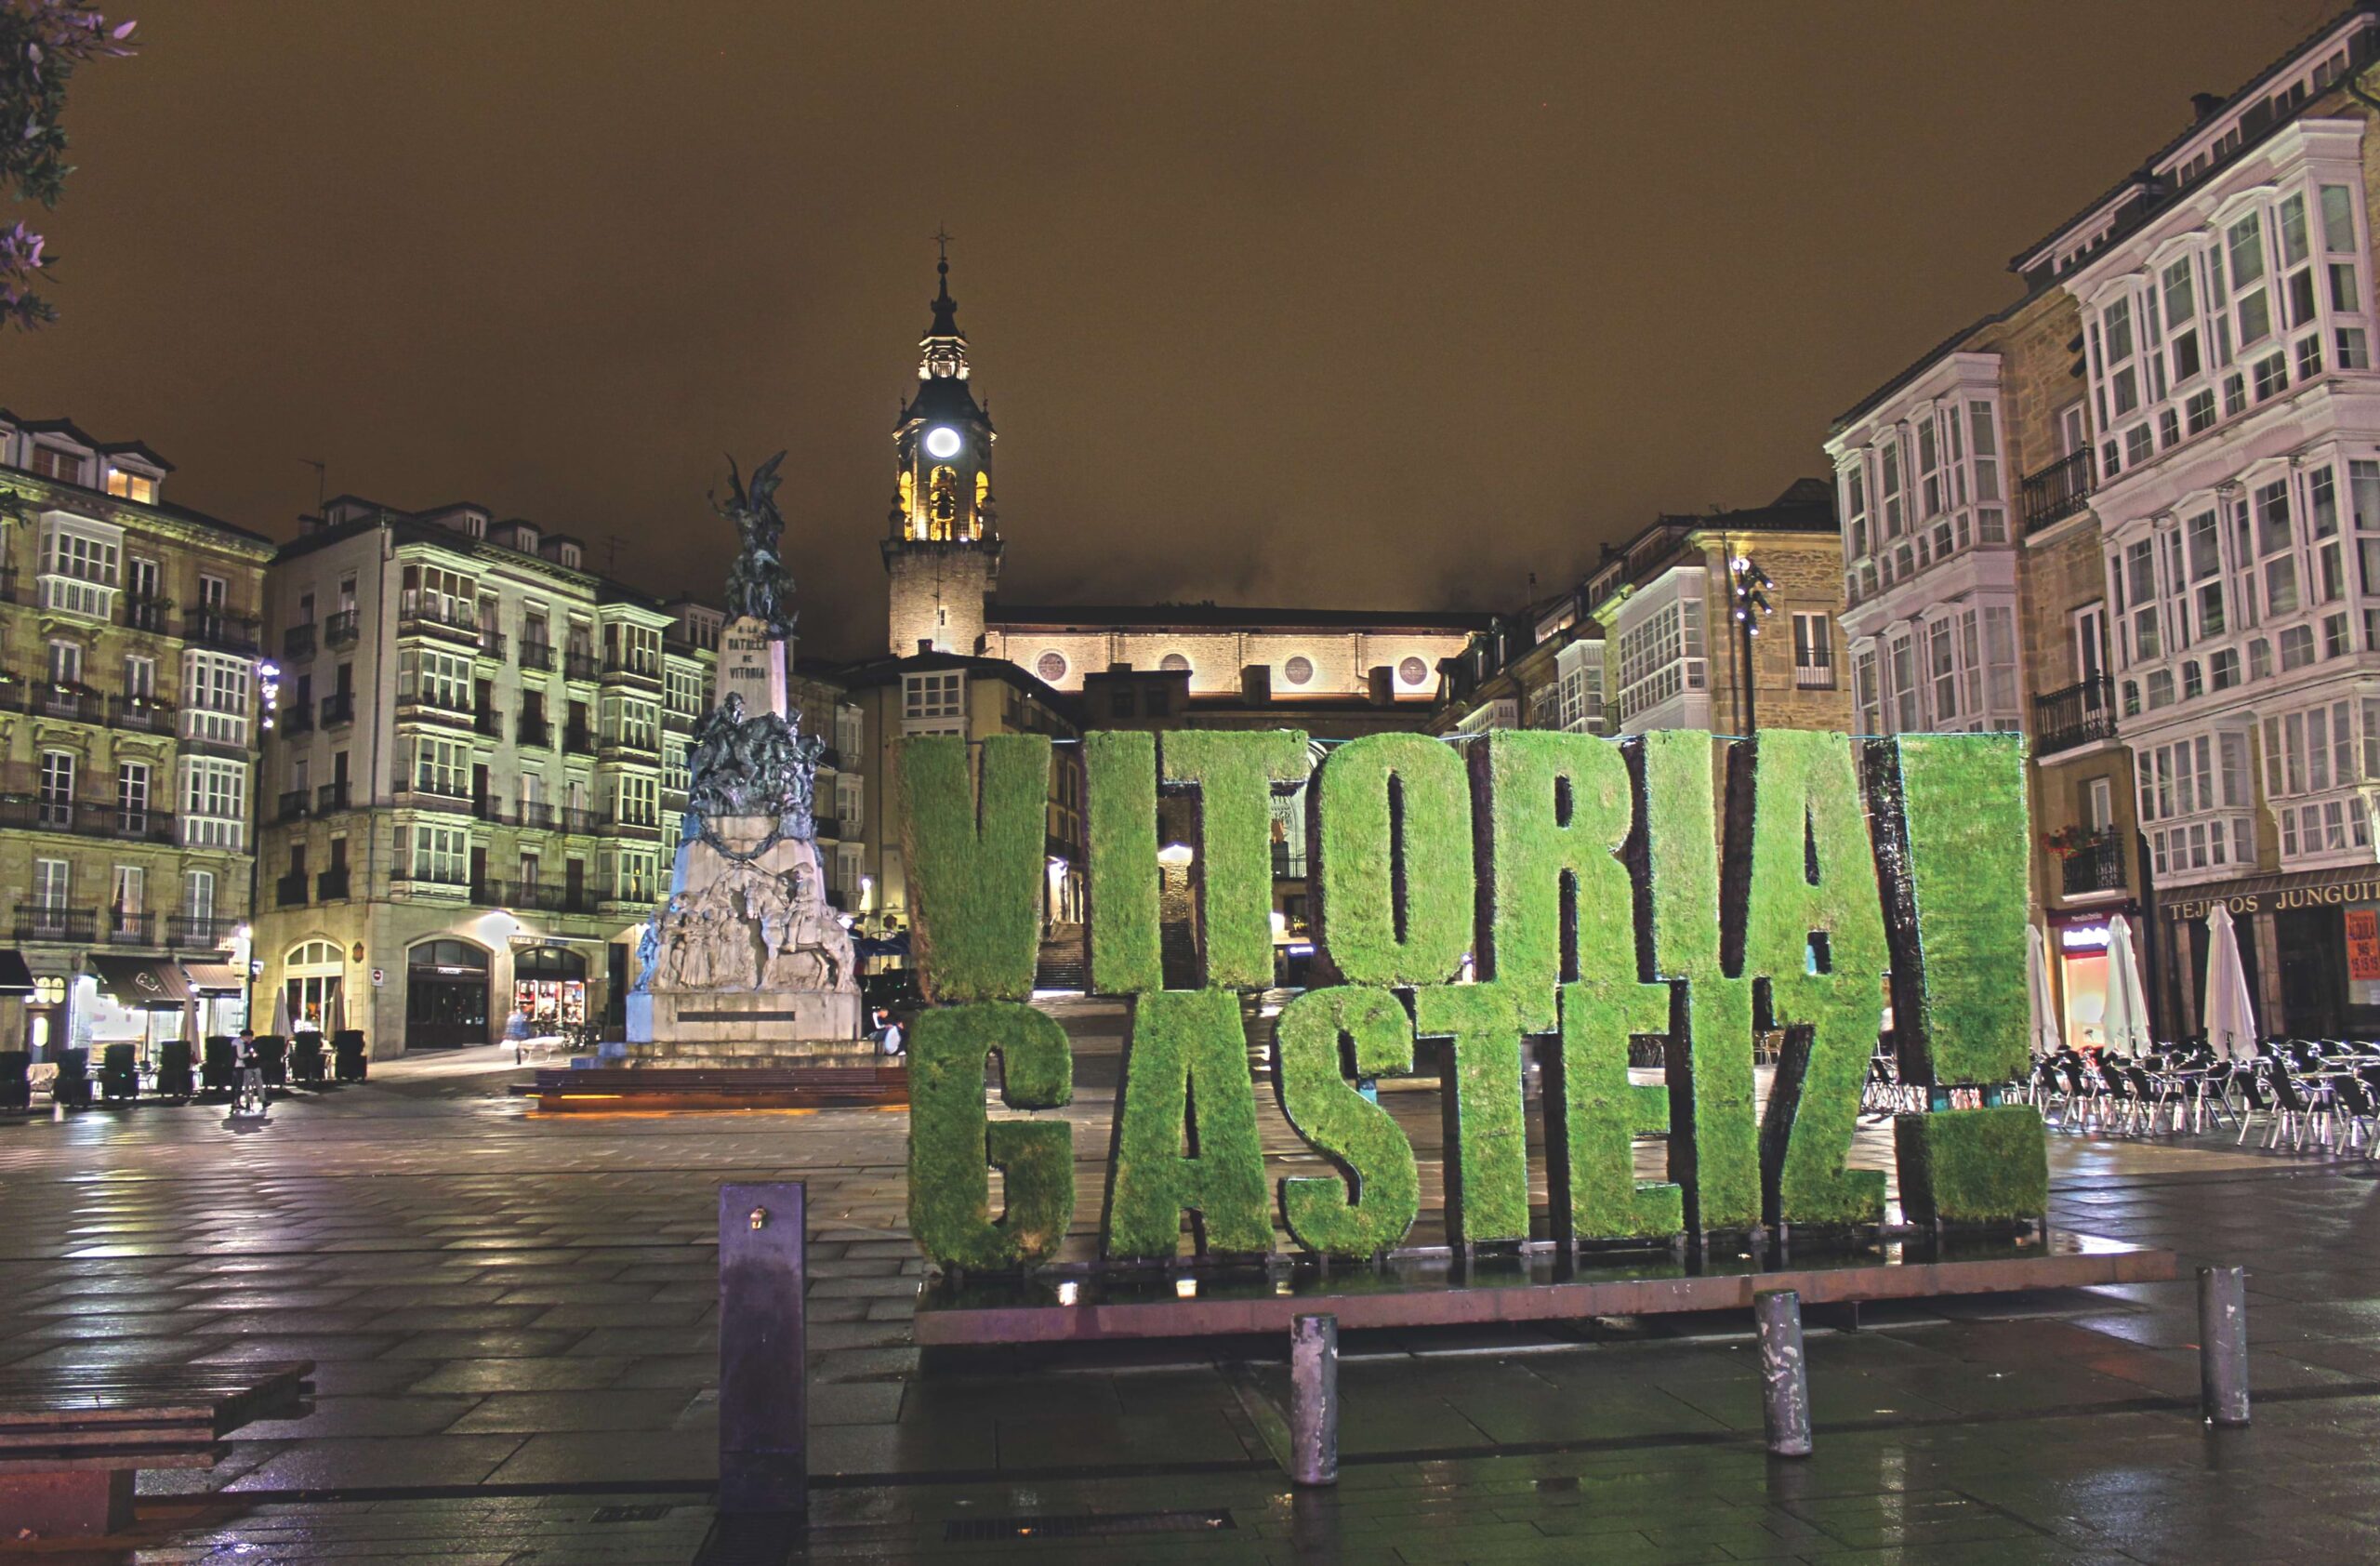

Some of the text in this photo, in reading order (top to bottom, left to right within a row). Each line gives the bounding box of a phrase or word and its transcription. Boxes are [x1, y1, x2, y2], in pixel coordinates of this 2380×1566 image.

[729, 667, 765, 679] VITORIA
[743, 655, 753, 663] DE
[892, 729, 1889, 1004] VITORIA
[906, 981, 1887, 1272] GASTEIZ
